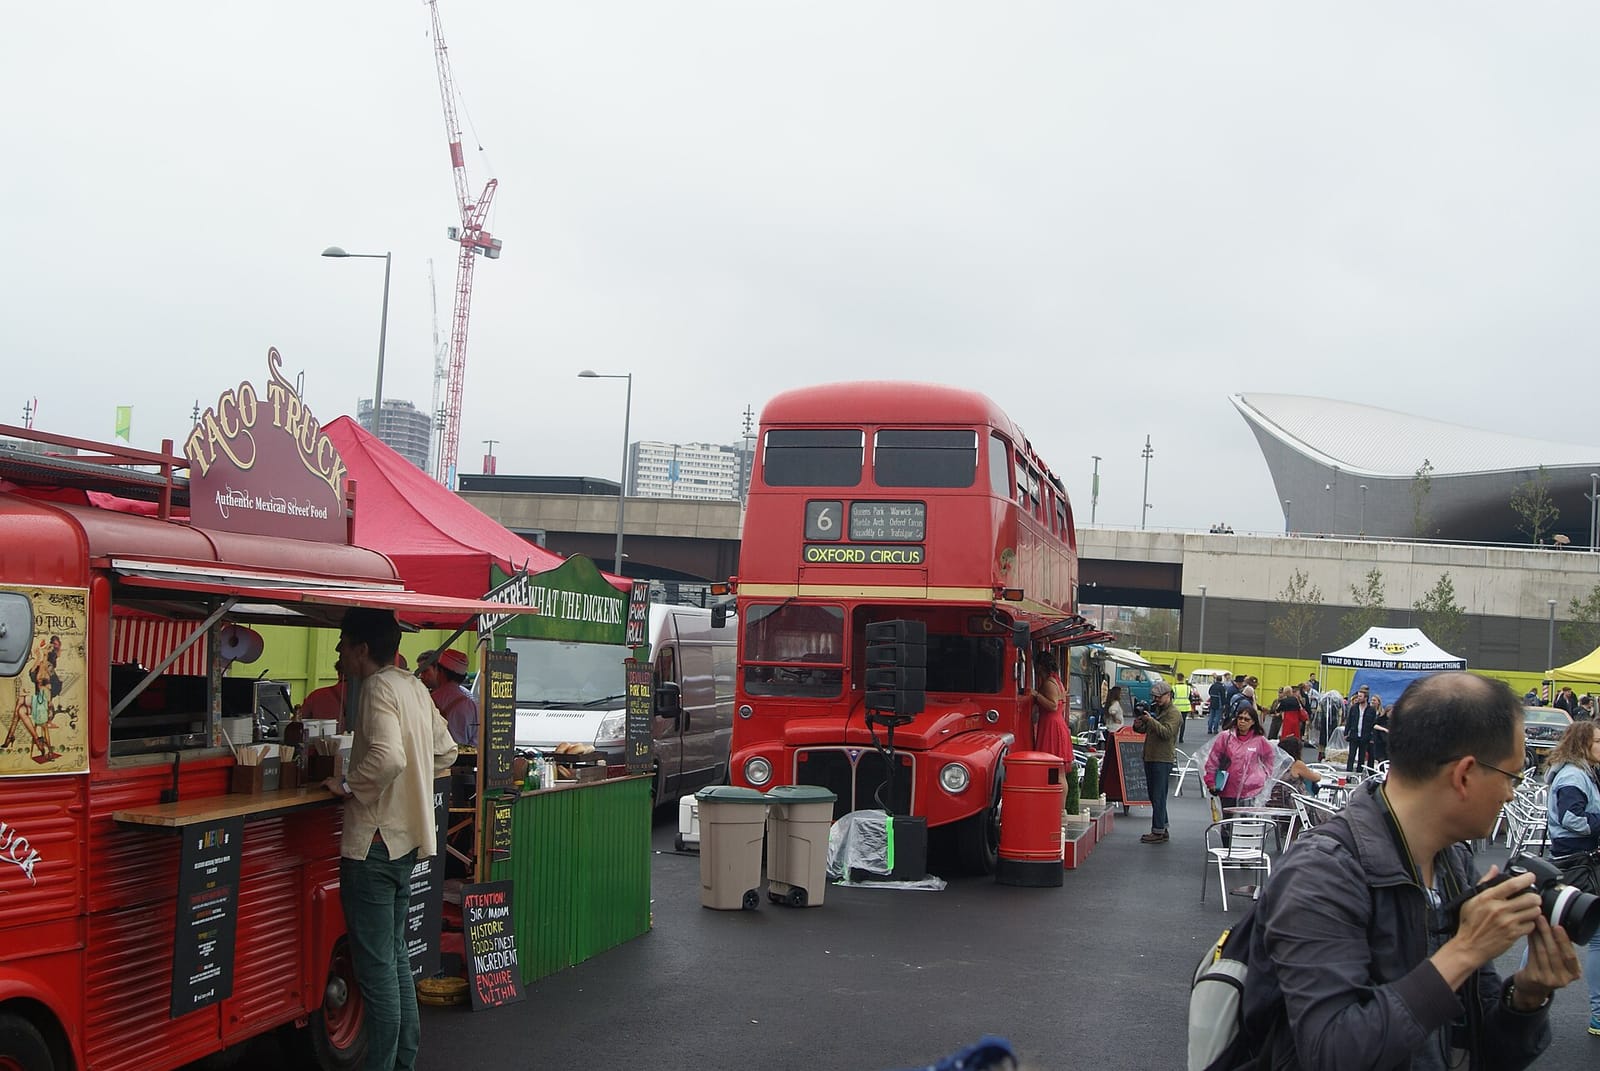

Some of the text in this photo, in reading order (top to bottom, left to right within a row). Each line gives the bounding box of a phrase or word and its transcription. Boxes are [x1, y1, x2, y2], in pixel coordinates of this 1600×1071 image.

[186, 351, 347, 508] TACO TRUCK
[215, 486, 328, 520] Authentic Mexican Street Food
[873, 507, 884, 516] Park
[890, 506, 911, 516] Warwick
[817, 507, 833, 531] 6
[873, 518, 885, 527] Arch
[889, 518, 906, 527] Oxford
[807, 548, 920, 563] OXFORD CIRCUS
[633, 584, 648, 601] HOT
[528, 585, 623, 625] WHAT THE DICKENS!
[630, 603, 648, 620] PORK
[45, 614, 78, 631] TRUCK
[982, 617, 993, 631] 6
[627, 622, 643, 642] ROLL
[1368, 641, 1420, 652] Martens
[1327, 657, 1343, 665] WHAT
[1343, 657, 1351, 665] DO
[1352, 659, 1364, 667] YOU
[1364, 660, 1381, 668] STAND
[629, 684, 651, 698] PORK ROLL
[495, 808, 511, 819] WATER
[0, 821, 42, 886] UCK
[464, 891, 506, 908] ATTENTION!
[470, 921, 504, 941] HISTORIC
[472, 935, 515, 955] FOODS FINEST
[474, 949, 518, 974] INGREDIENT
[476, 970, 513, 992] ENQUIRE
[479, 984, 517, 1004] WITHIN
